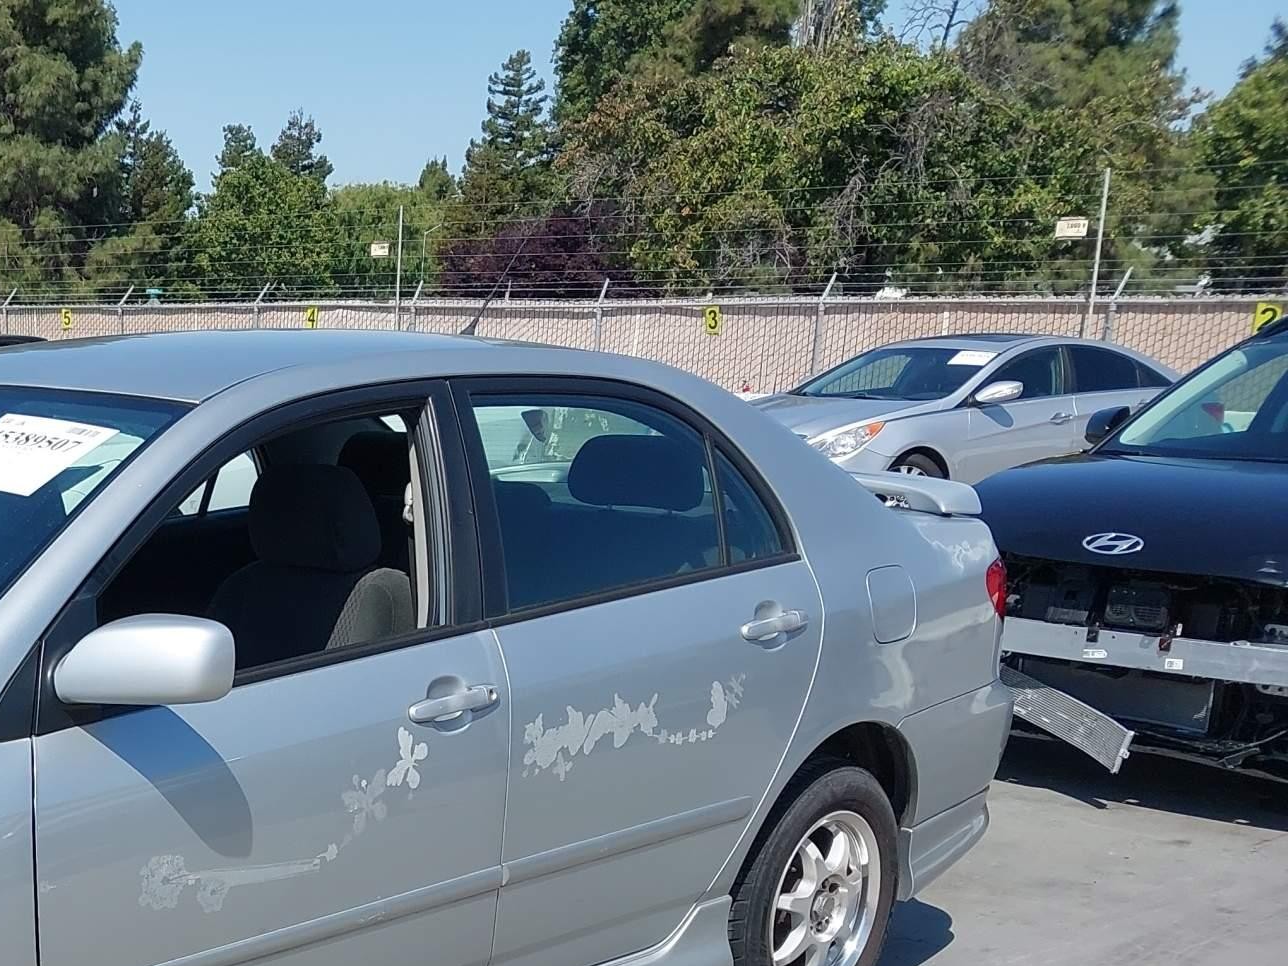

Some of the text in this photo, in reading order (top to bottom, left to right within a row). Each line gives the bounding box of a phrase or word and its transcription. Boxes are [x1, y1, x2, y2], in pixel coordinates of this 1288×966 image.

[63, 311, 71, 326] 5
[308, 309, 315, 328] 4
[708, 309, 718, 329] 3
[1256, 307, 1278, 331] 2
